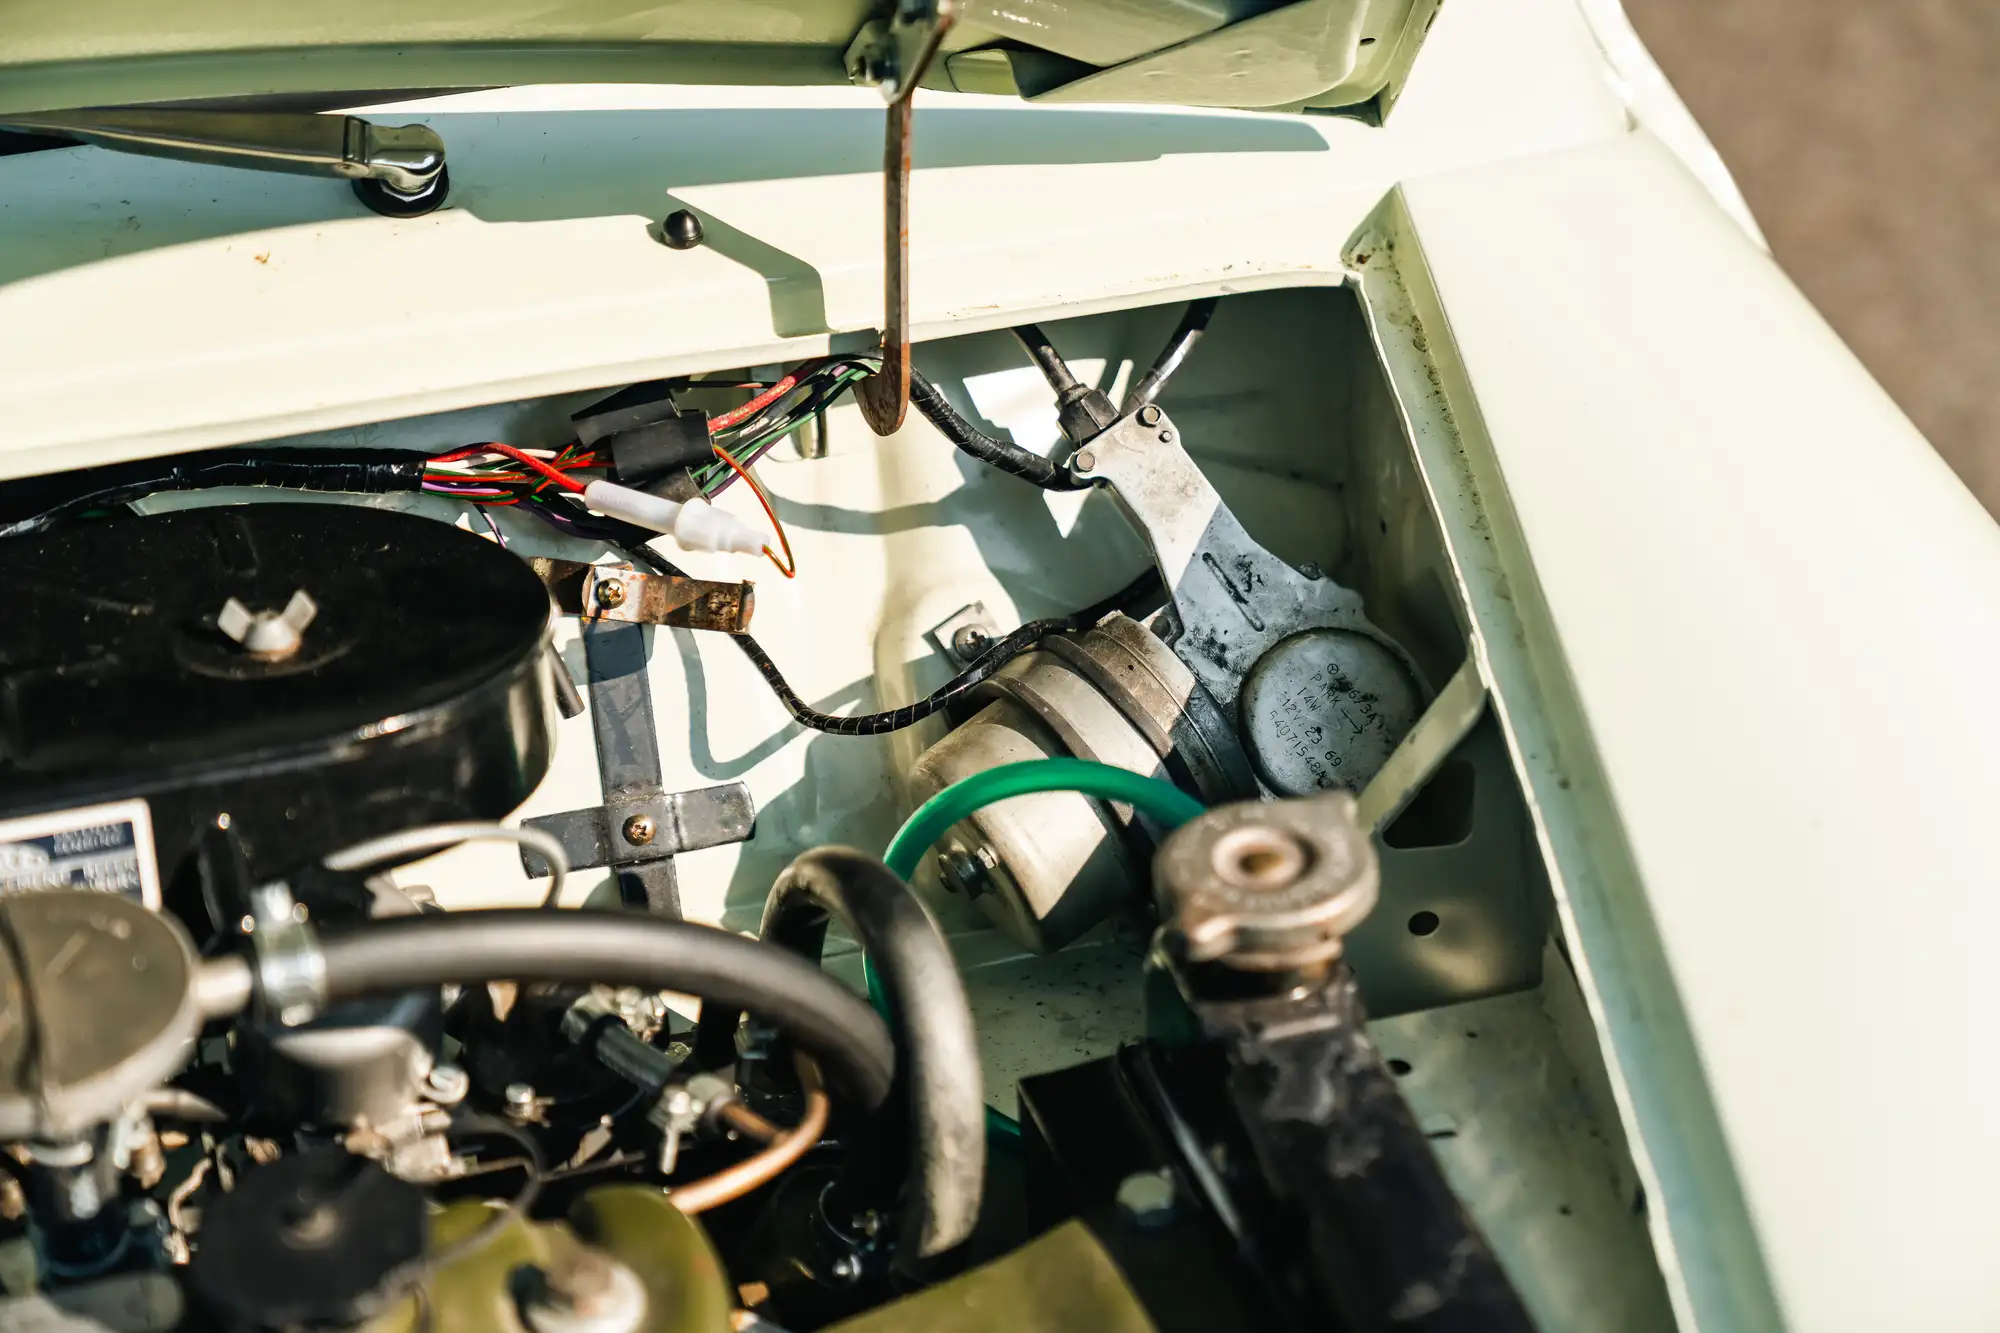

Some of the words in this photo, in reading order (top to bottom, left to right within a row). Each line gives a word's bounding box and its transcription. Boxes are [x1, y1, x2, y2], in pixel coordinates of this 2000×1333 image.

[1297, 687, 1322, 711] 14W
[1310, 673, 1342, 708] PARK
[1305, 727, 1323, 744] 23
[1325, 751, 1342, 767] 69
